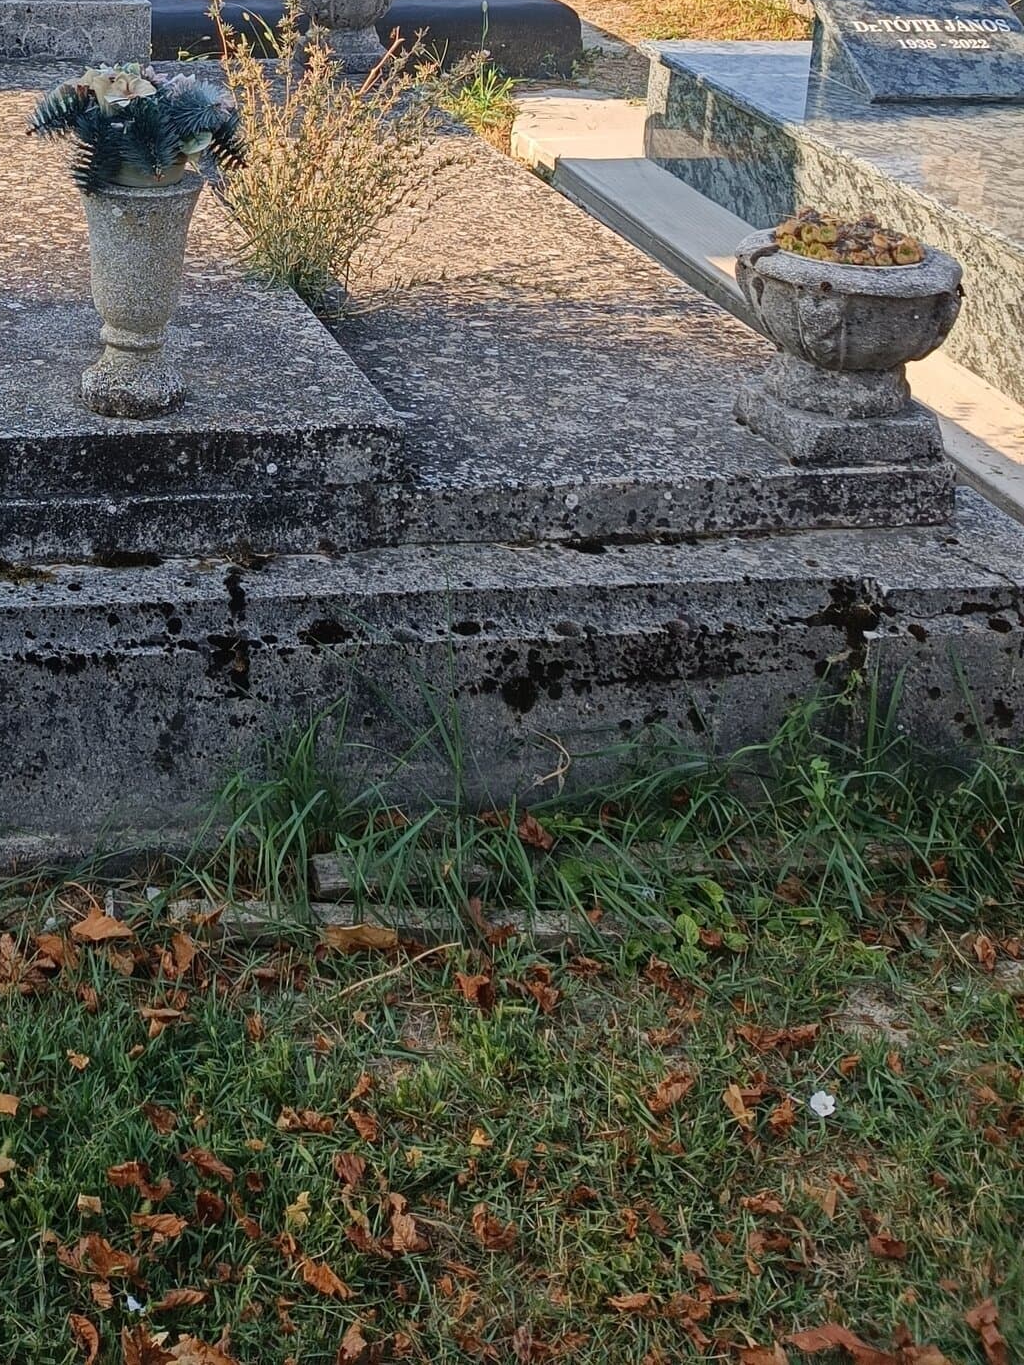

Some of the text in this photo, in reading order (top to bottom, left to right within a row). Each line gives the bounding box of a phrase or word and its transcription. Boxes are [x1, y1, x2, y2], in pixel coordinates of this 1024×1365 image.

[878, 16, 944, 33] TÓTH
[944, 15, 1012, 33] JÁNOS
[897, 38, 937, 50] 1938
[950, 38, 990, 50] 2022
